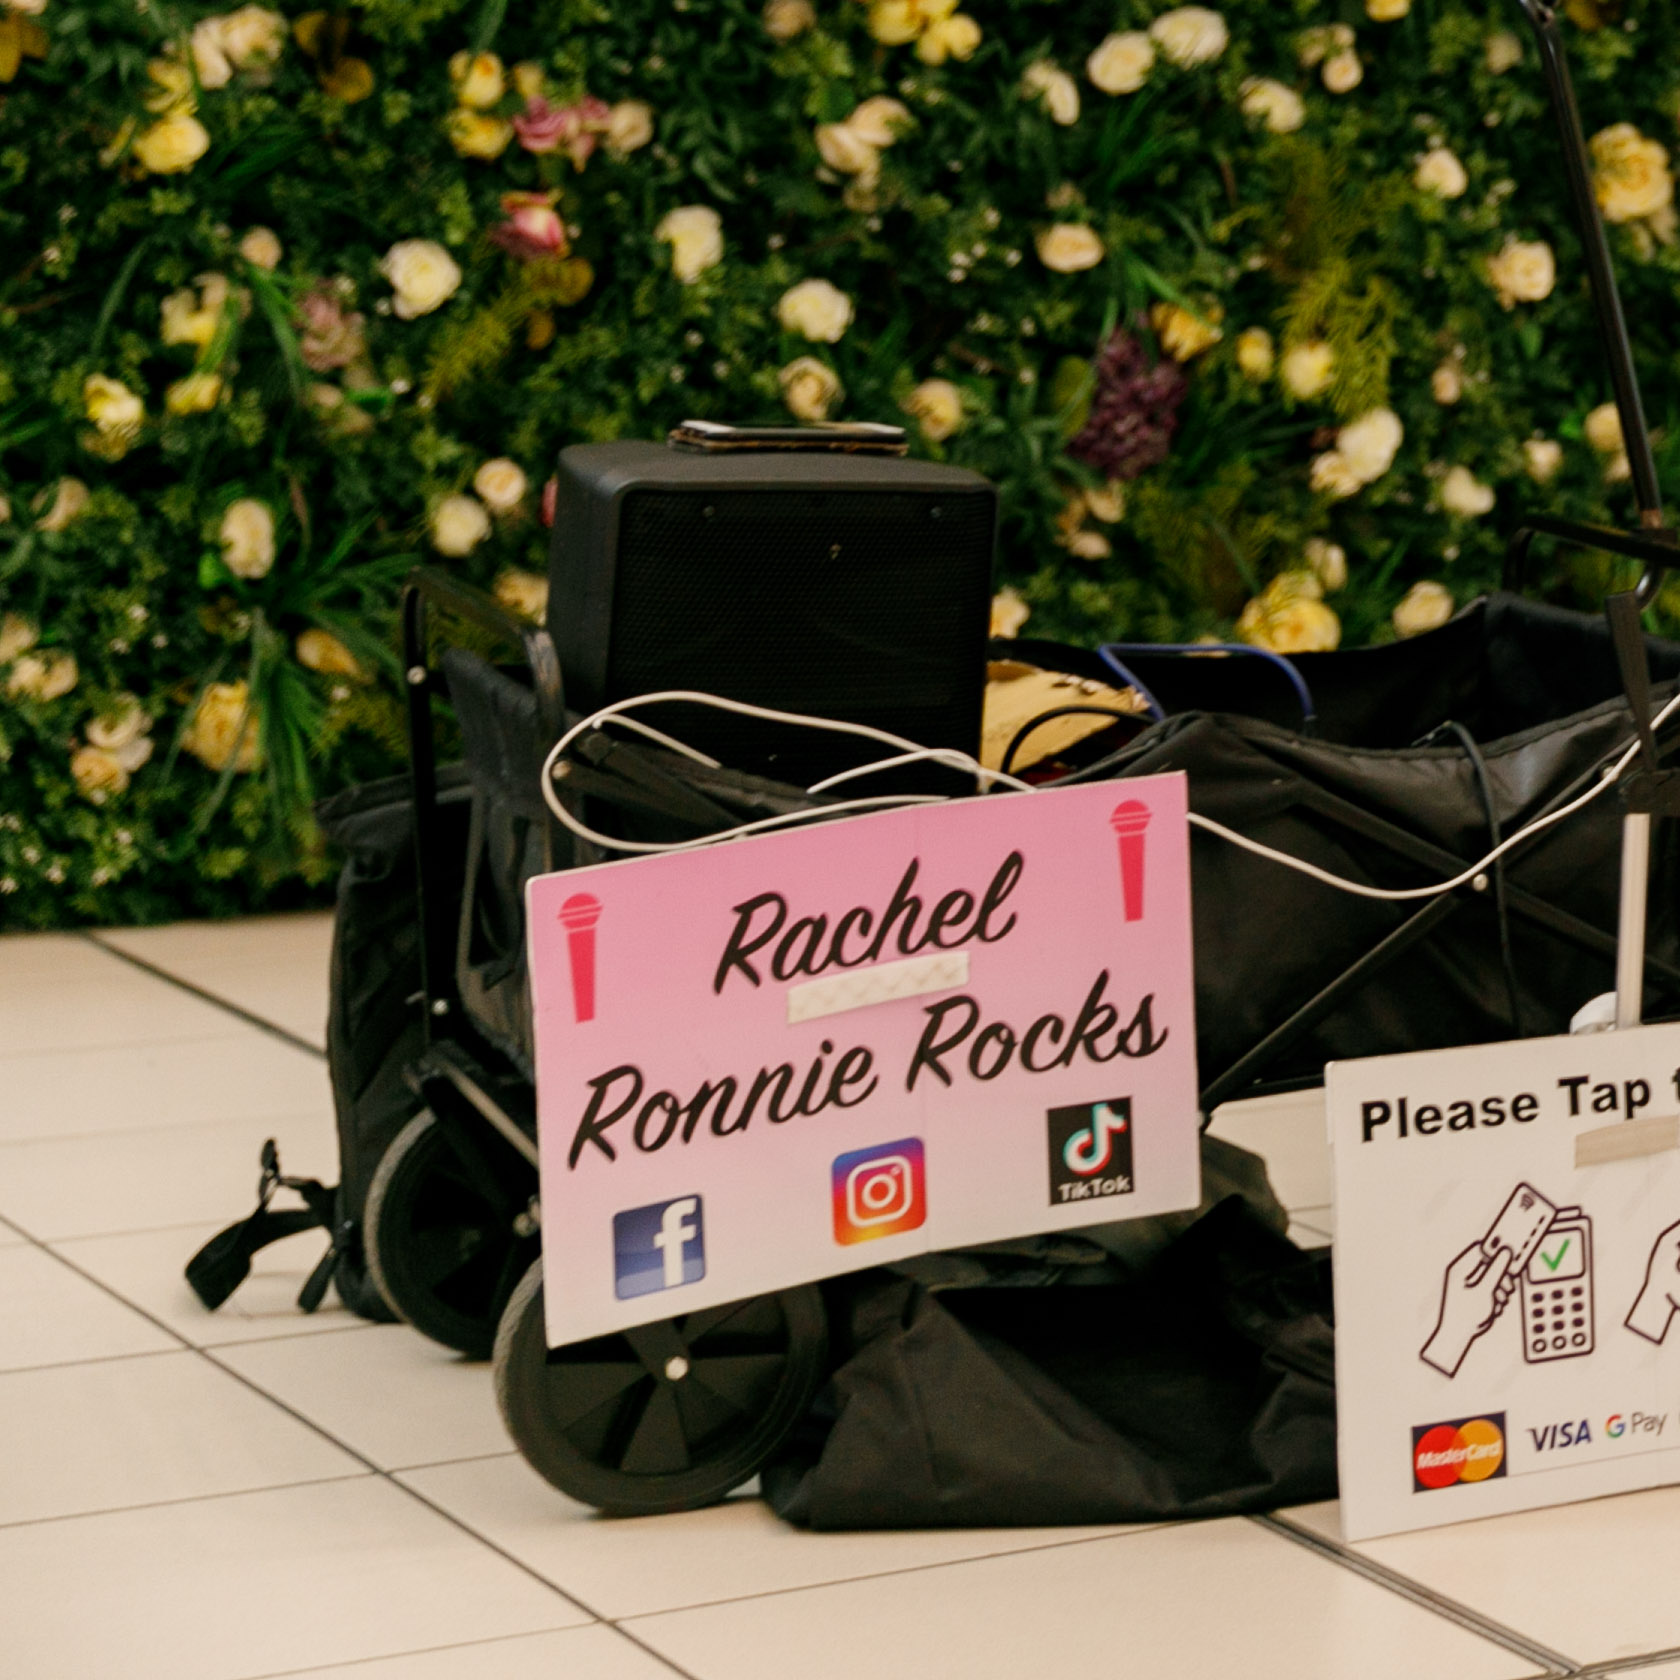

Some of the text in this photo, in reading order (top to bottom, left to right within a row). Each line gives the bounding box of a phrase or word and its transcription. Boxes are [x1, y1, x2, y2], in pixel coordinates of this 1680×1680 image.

[714, 850, 1026, 995] Rachel
[567, 968, 1170, 1171] Ronnie Rocks
[1360, 1090, 1540, 1144] Please
[1558, 1075, 1651, 1120] Tap
[1058, 1175, 1130, 1201] TikTok
[1526, 1418, 1593, 1453] VISA
[1631, 1410, 1669, 1437] Pay
[1416, 1438, 1502, 1470] MasterCard
